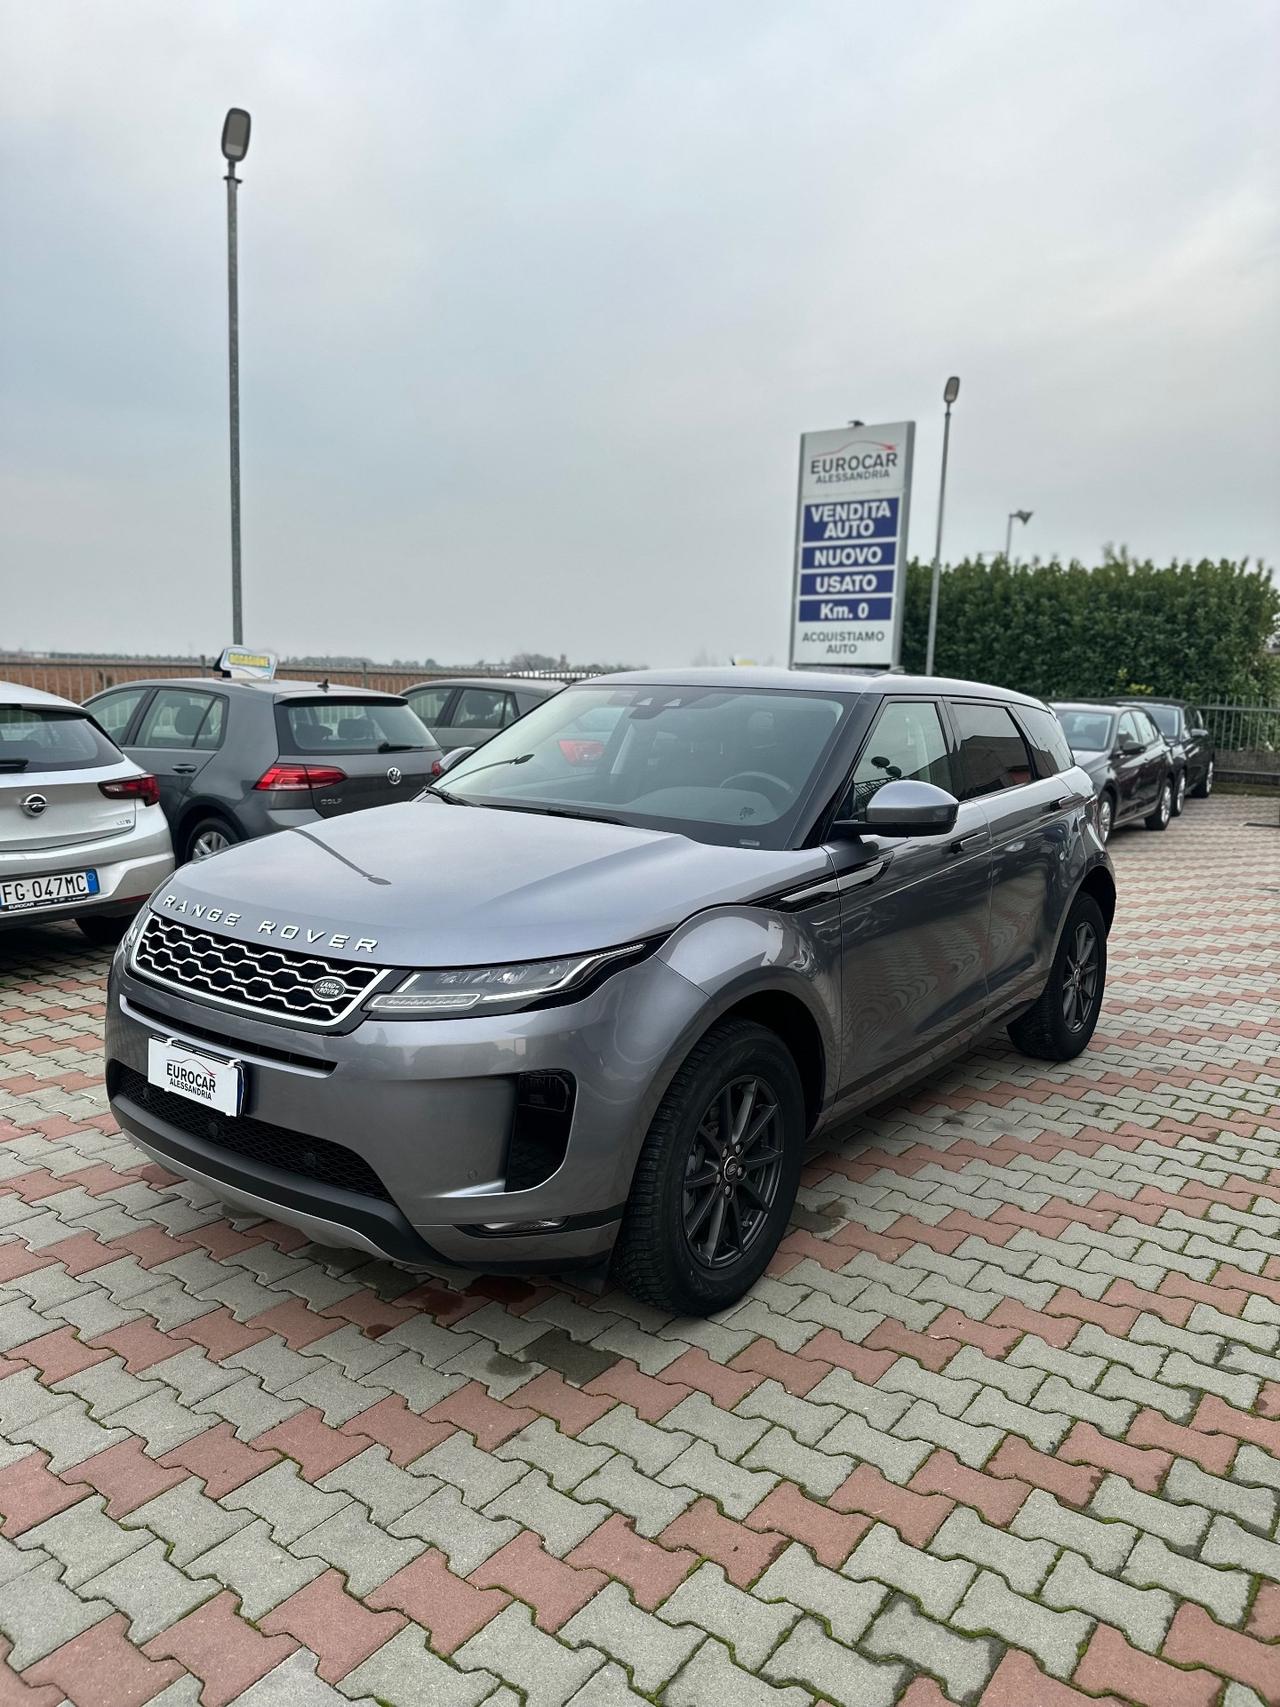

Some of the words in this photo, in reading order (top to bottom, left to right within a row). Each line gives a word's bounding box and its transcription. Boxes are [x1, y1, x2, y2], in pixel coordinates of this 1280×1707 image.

[810, 452, 898, 475] EUROCAR
[815, 469, 891, 484] ALESSANDRIA
[810, 500, 891, 523] VENDITA
[823, 519, 875, 539] AUTO
[813, 546, 882, 567] NUOVO
[815, 574, 877, 593] USATO
[819, 602, 853, 620] Km.
[857, 602, 869, 618] 0
[802, 630, 885, 643] ACQUISTIAMO
[826, 643, 857, 655] AUTO
[162, 894, 242, 927] RANGE
[257, 919, 380, 954] ROVER
[319, 981, 337, 989] LAND
[319, 987, 340, 996] ROVER
[166, 1062, 217, 1094] EUROCAR
[169, 1078, 213, 1101] ALESSANDRIA
